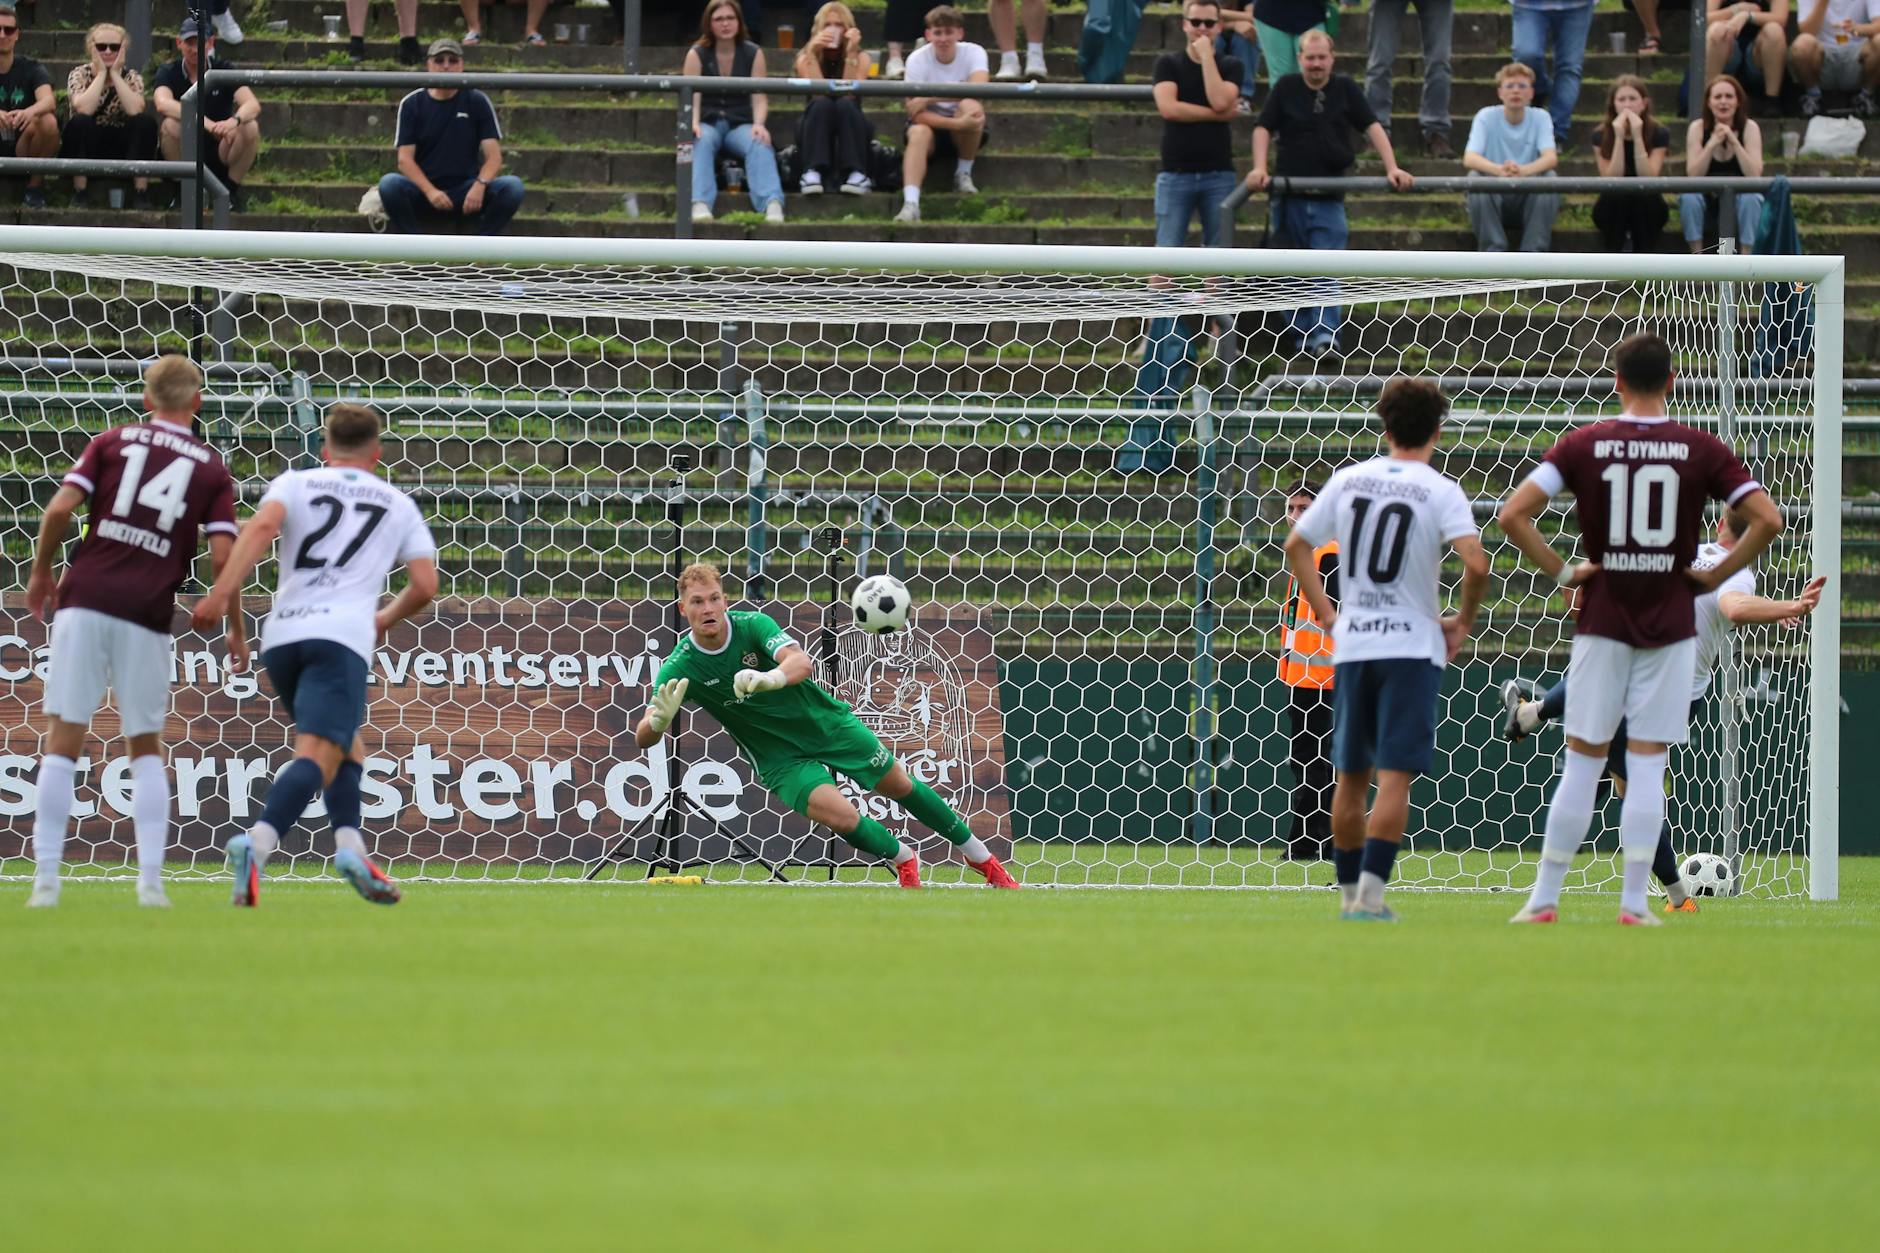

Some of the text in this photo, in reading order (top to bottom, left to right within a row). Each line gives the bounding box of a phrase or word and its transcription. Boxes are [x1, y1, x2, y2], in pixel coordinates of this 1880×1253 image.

[111, 443, 196, 534] 14
[1594, 440, 1689, 460] BFC DYNAMO
[294, 494, 389, 569] 27
[1348, 496, 1414, 584] 10
[1601, 463, 1680, 547] 10
[1348, 617, 1412, 635] Katjes
